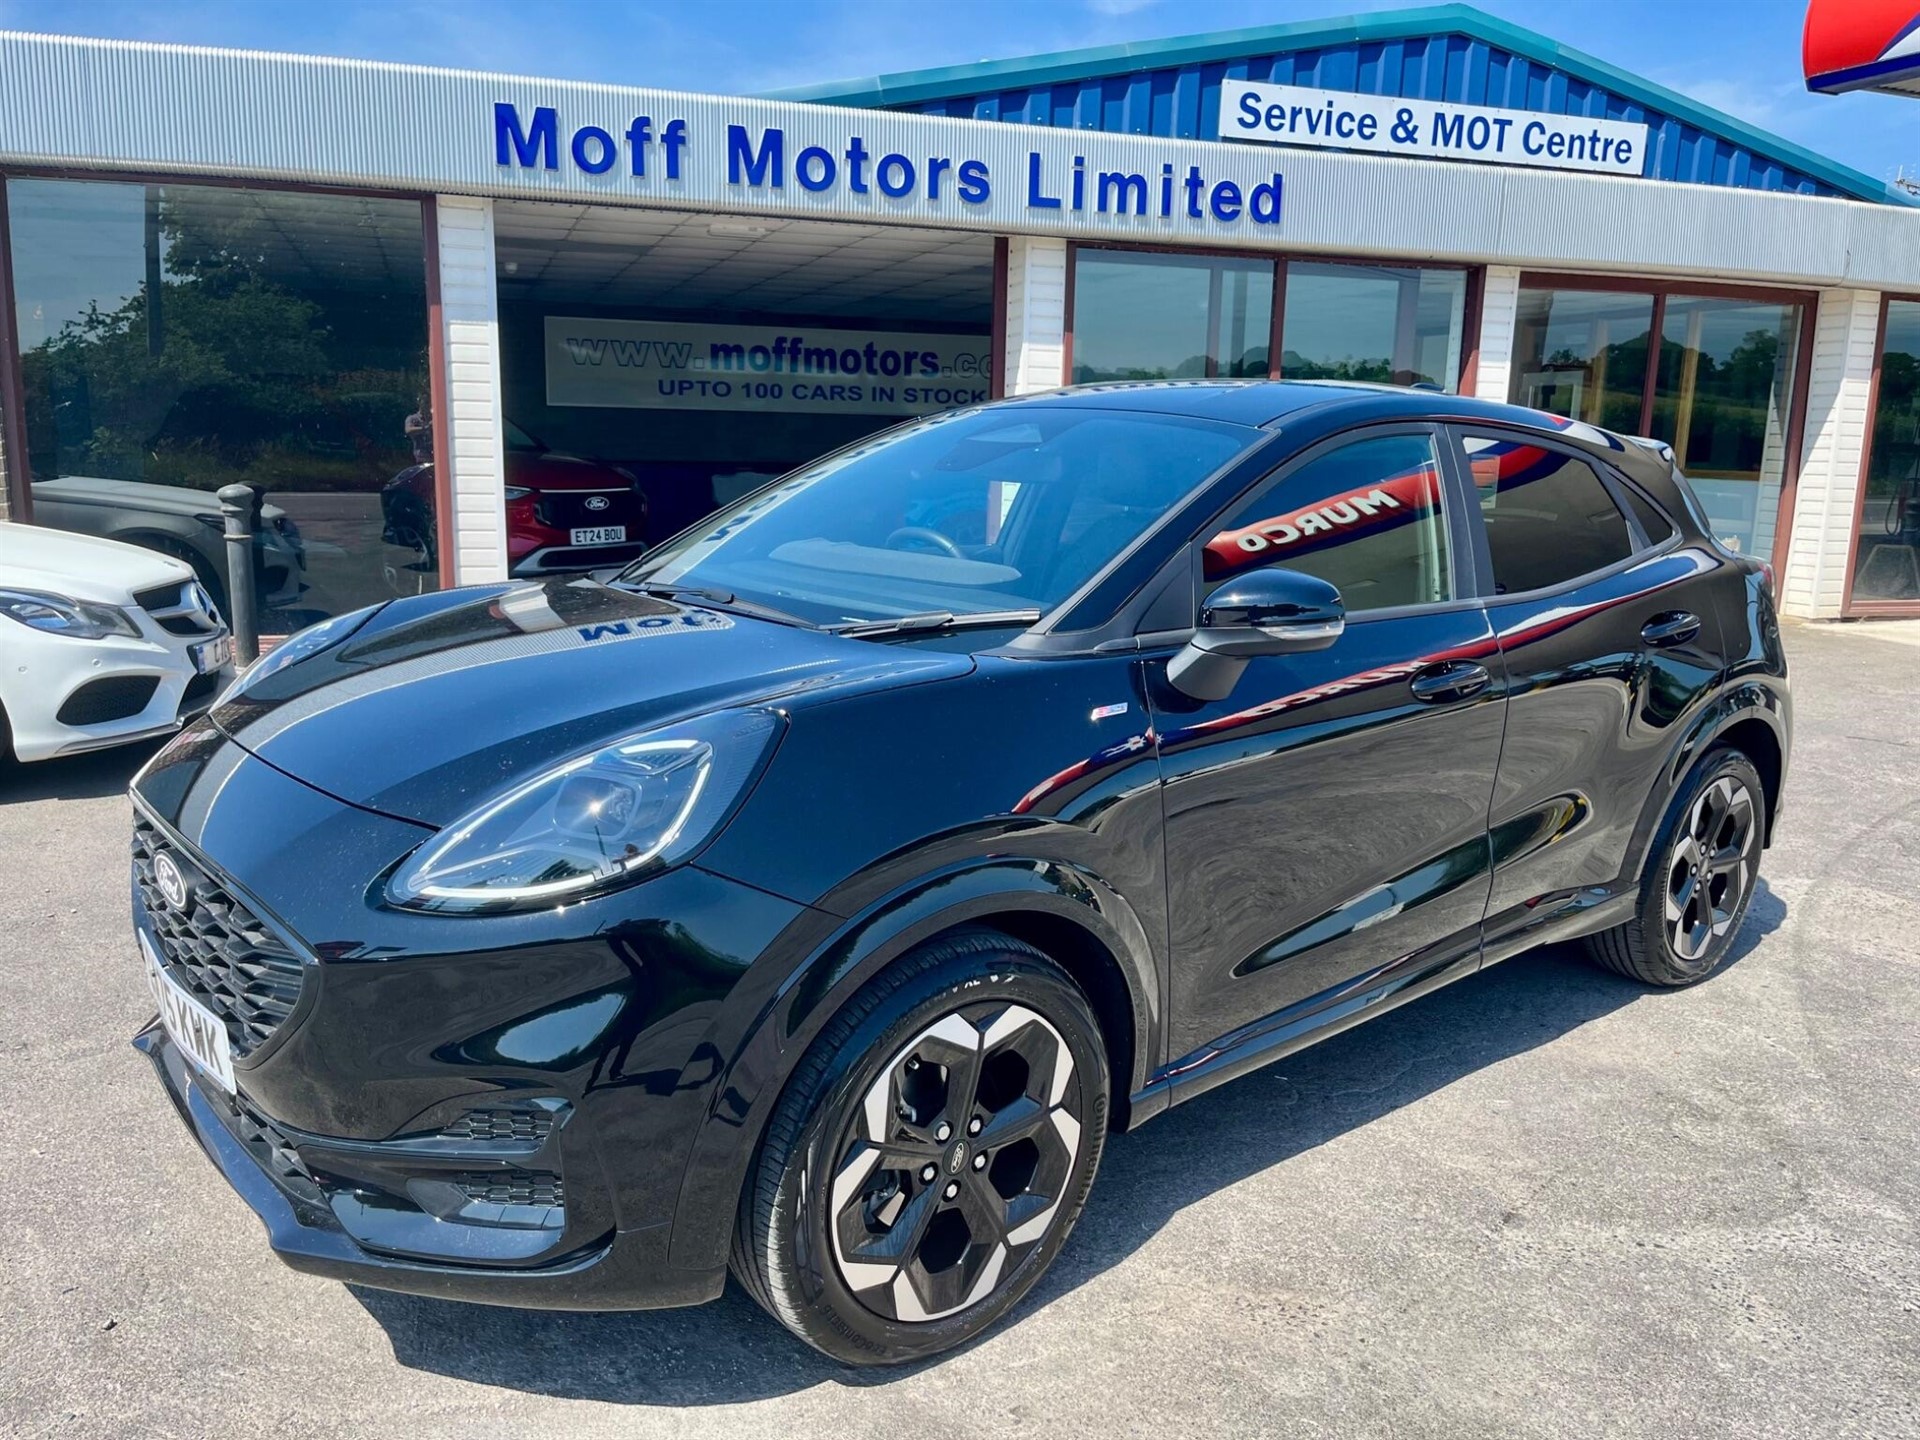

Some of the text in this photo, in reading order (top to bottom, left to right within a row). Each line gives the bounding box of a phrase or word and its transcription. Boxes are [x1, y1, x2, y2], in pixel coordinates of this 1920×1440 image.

[1237, 92, 1632, 164] Service & MOT Centre
[494, 102, 1283, 224] Moff Motors Limited
[658, 379, 986, 404] UPTO 100 CARS IN STOCK
[575, 528, 622, 543] ET24 BOU
[158, 859, 181, 903] Ford
